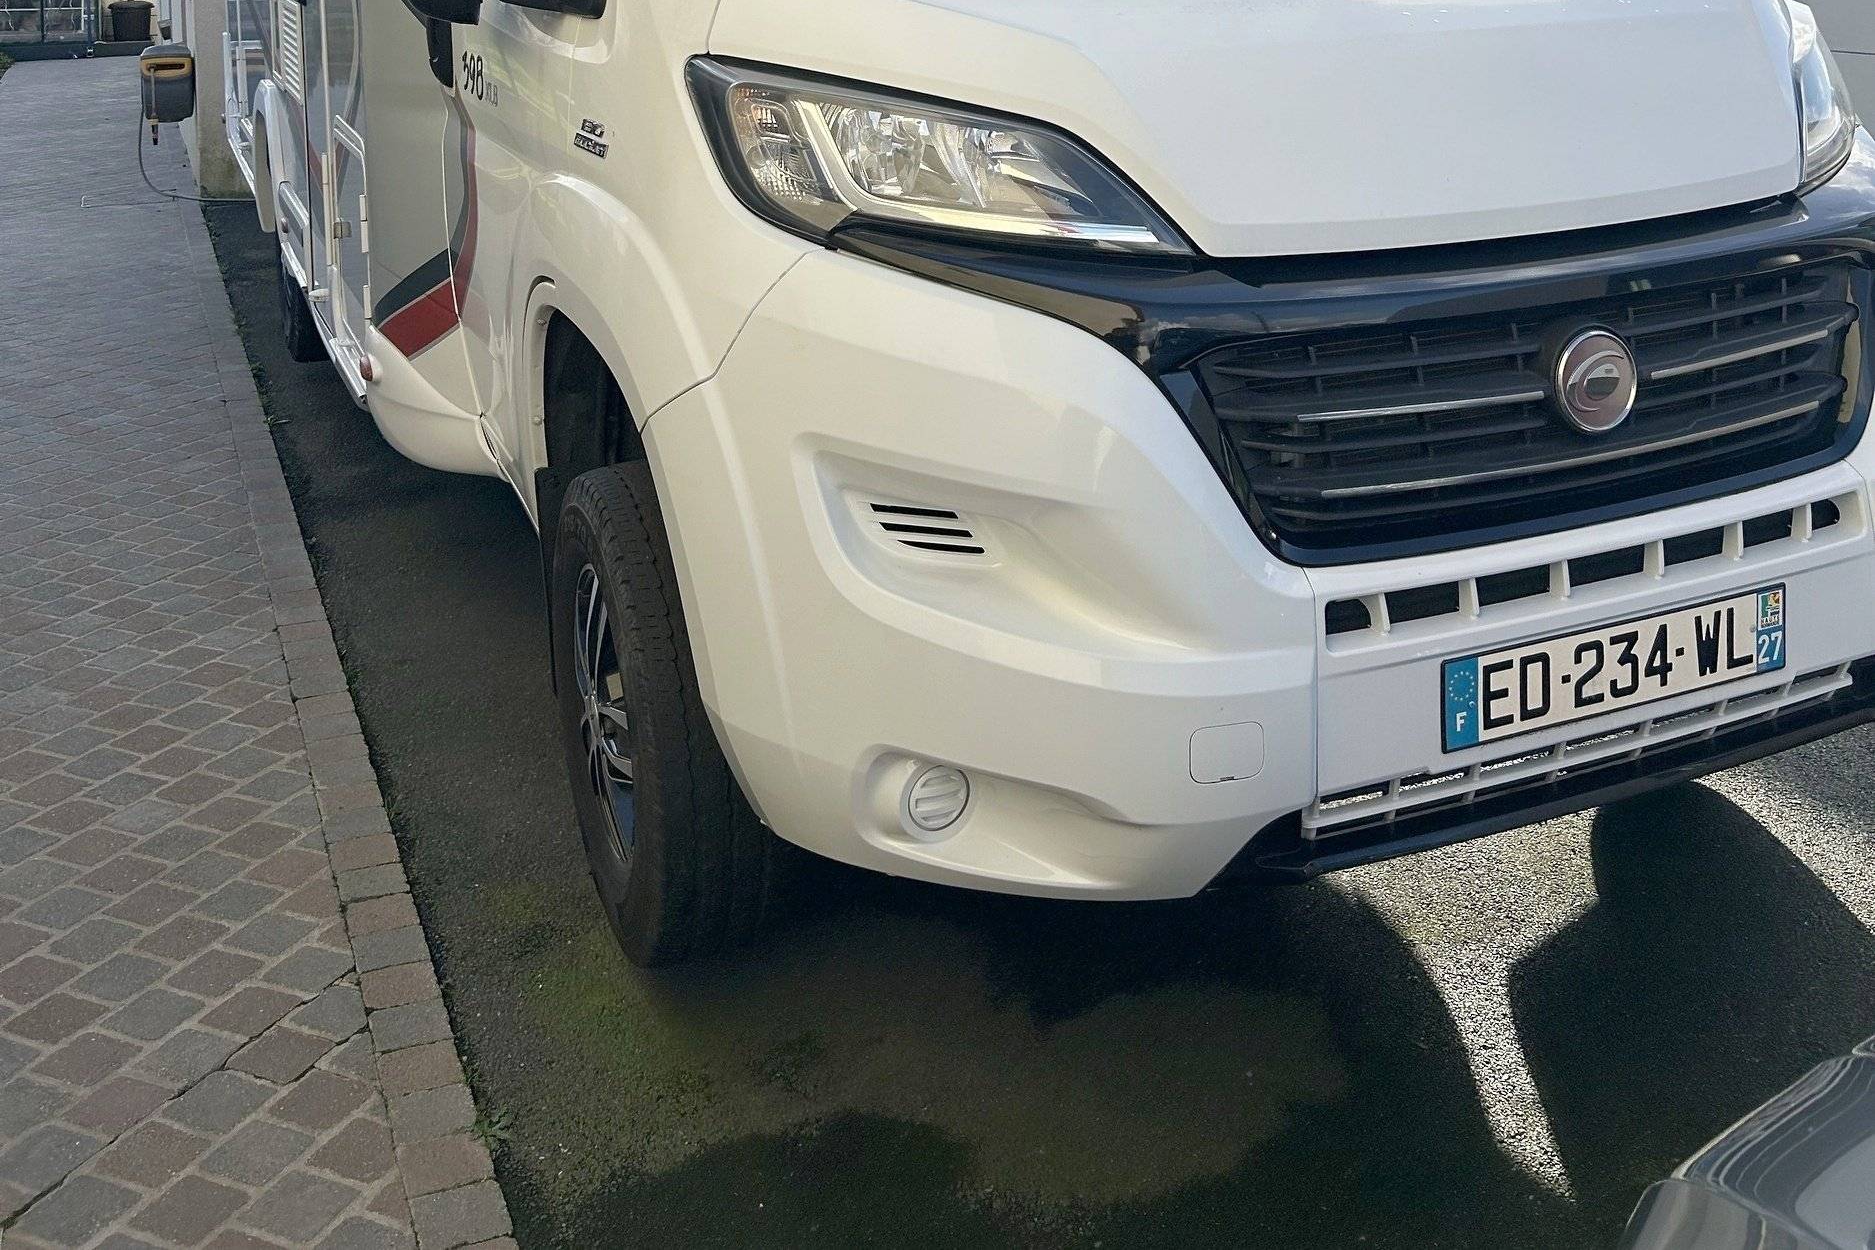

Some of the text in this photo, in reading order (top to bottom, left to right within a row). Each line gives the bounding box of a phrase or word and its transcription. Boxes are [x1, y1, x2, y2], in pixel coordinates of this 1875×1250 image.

[462, 51, 484, 101] 398
[1455, 607, 1783, 732] F ED-234-WL 27
